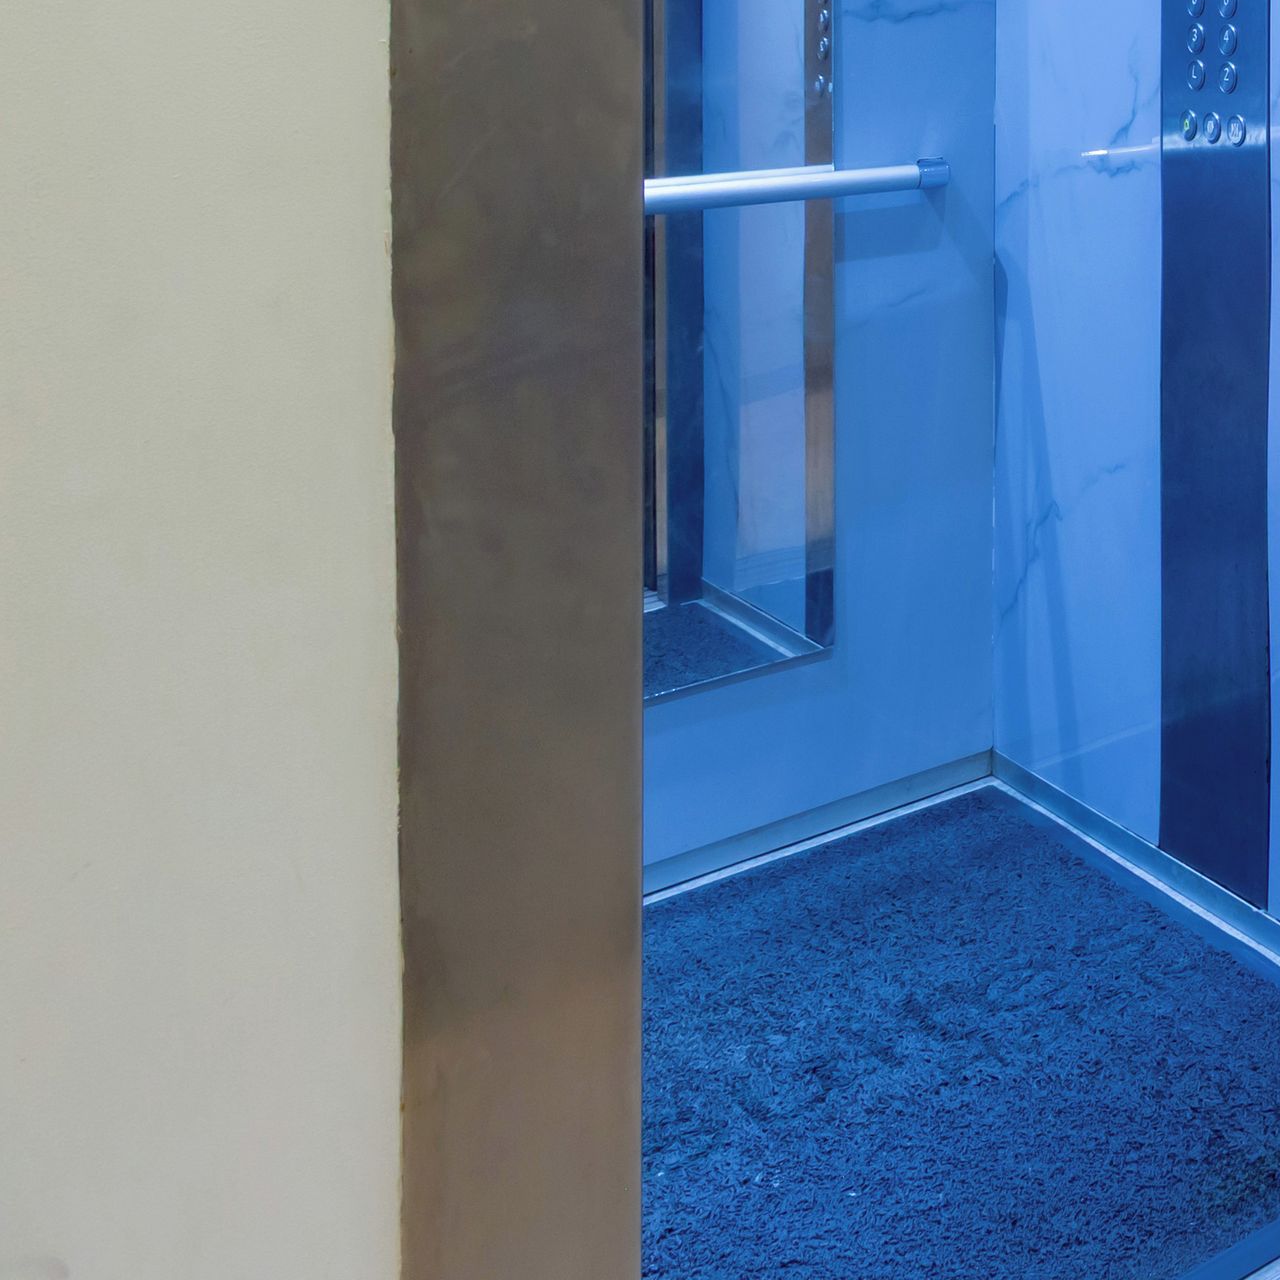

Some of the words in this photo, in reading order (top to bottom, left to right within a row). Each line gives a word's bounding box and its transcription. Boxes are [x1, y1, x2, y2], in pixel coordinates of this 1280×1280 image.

[1192, 28, 1198, 42] 3
[1223, 30, 1229, 43] 4
[1191, 65, 1197, 79] L
[1223, 67, 1229, 81] 2
